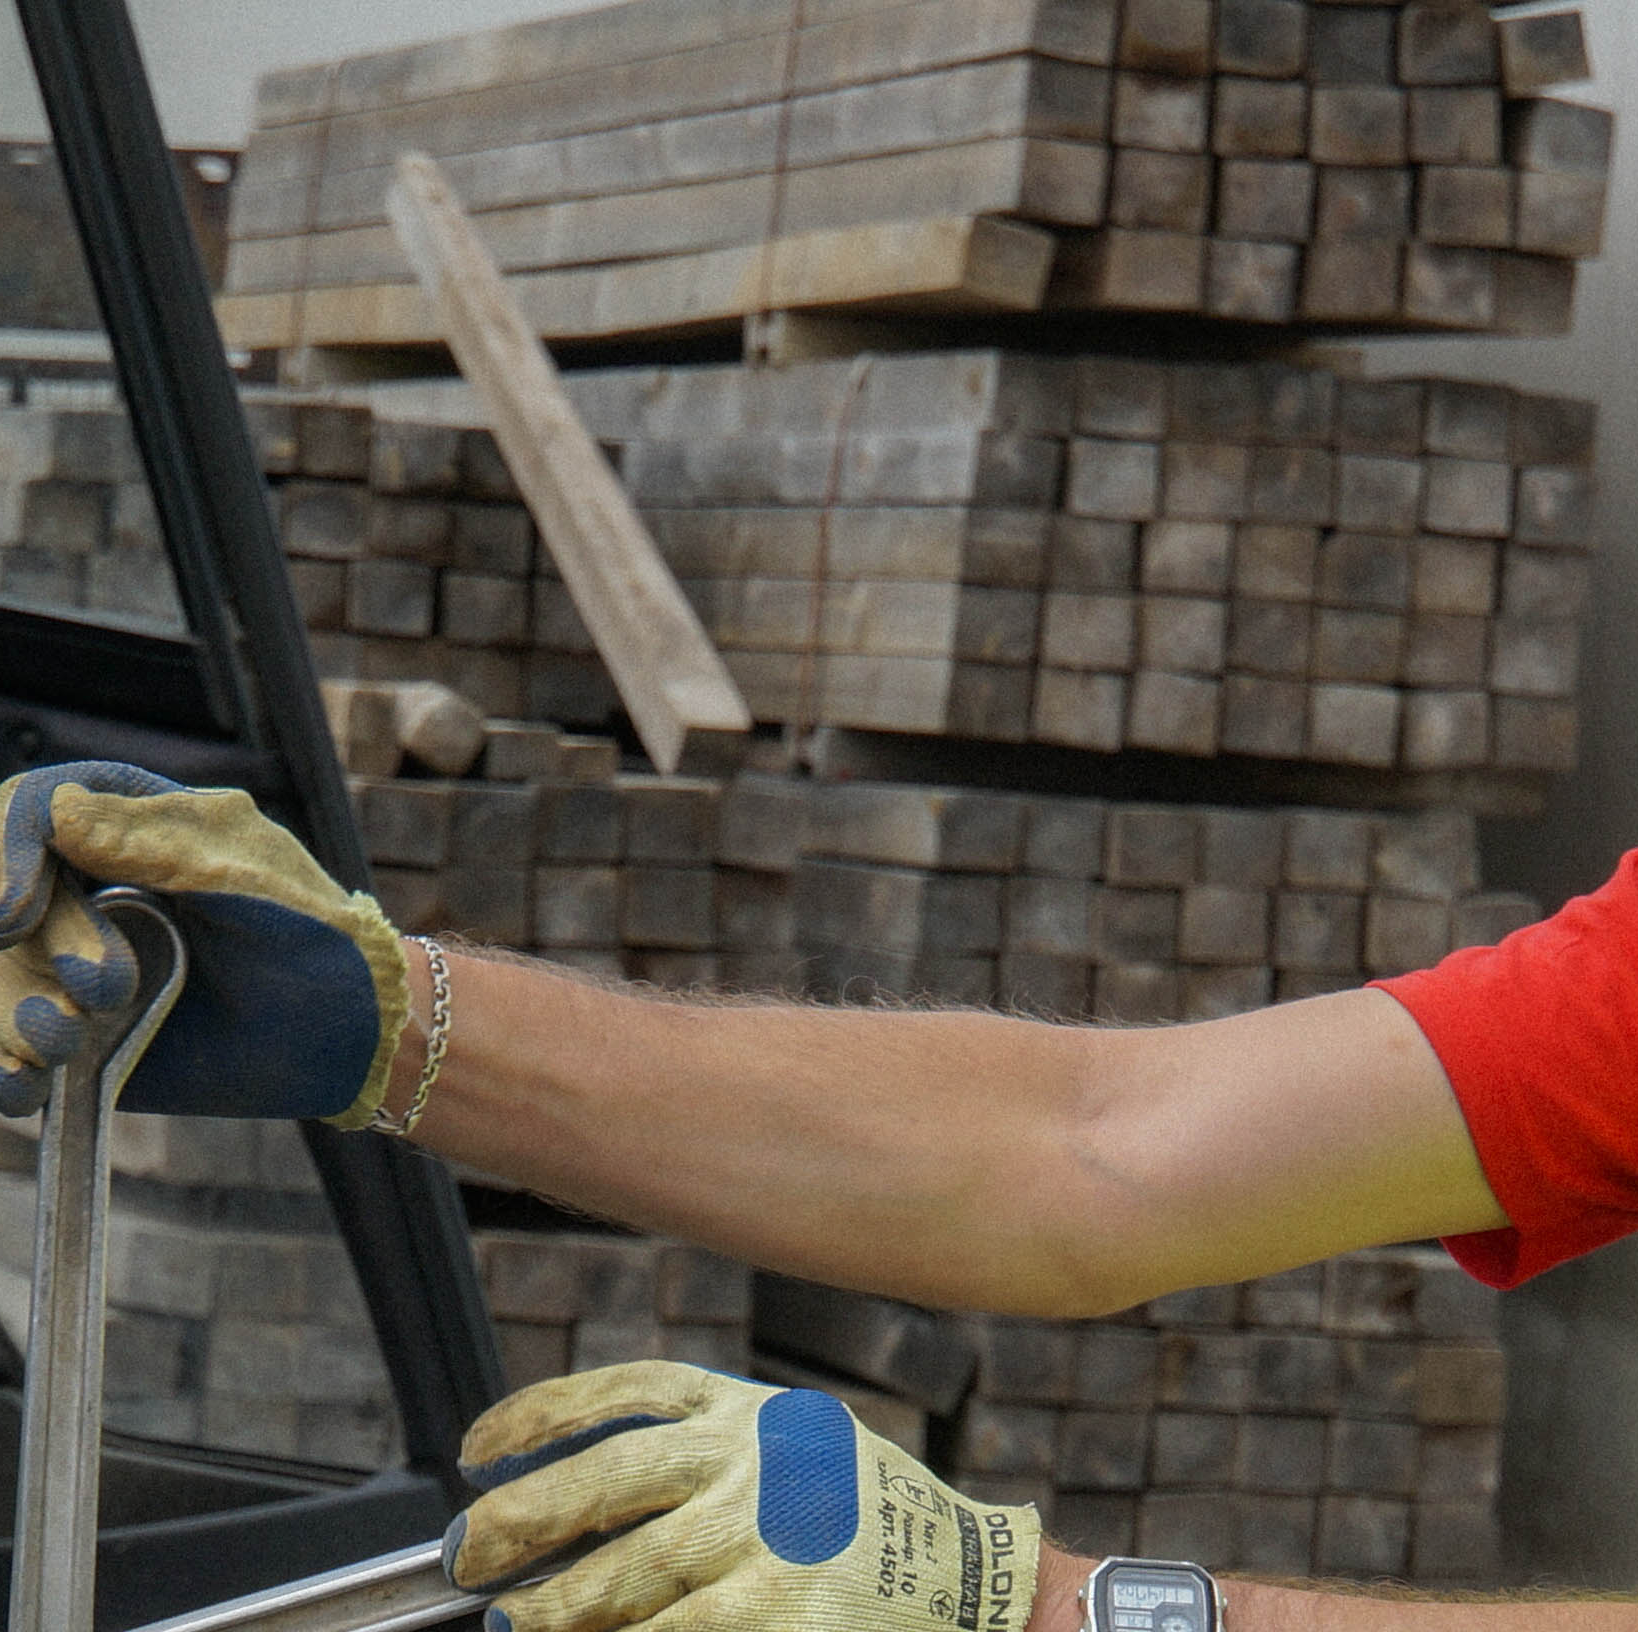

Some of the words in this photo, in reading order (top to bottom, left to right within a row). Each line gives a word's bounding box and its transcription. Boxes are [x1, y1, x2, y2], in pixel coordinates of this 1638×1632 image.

[877, 1497, 897, 1538] Арт.
[877, 1543, 897, 1598] 4502
[900, 1571, 917, 1595] 10
